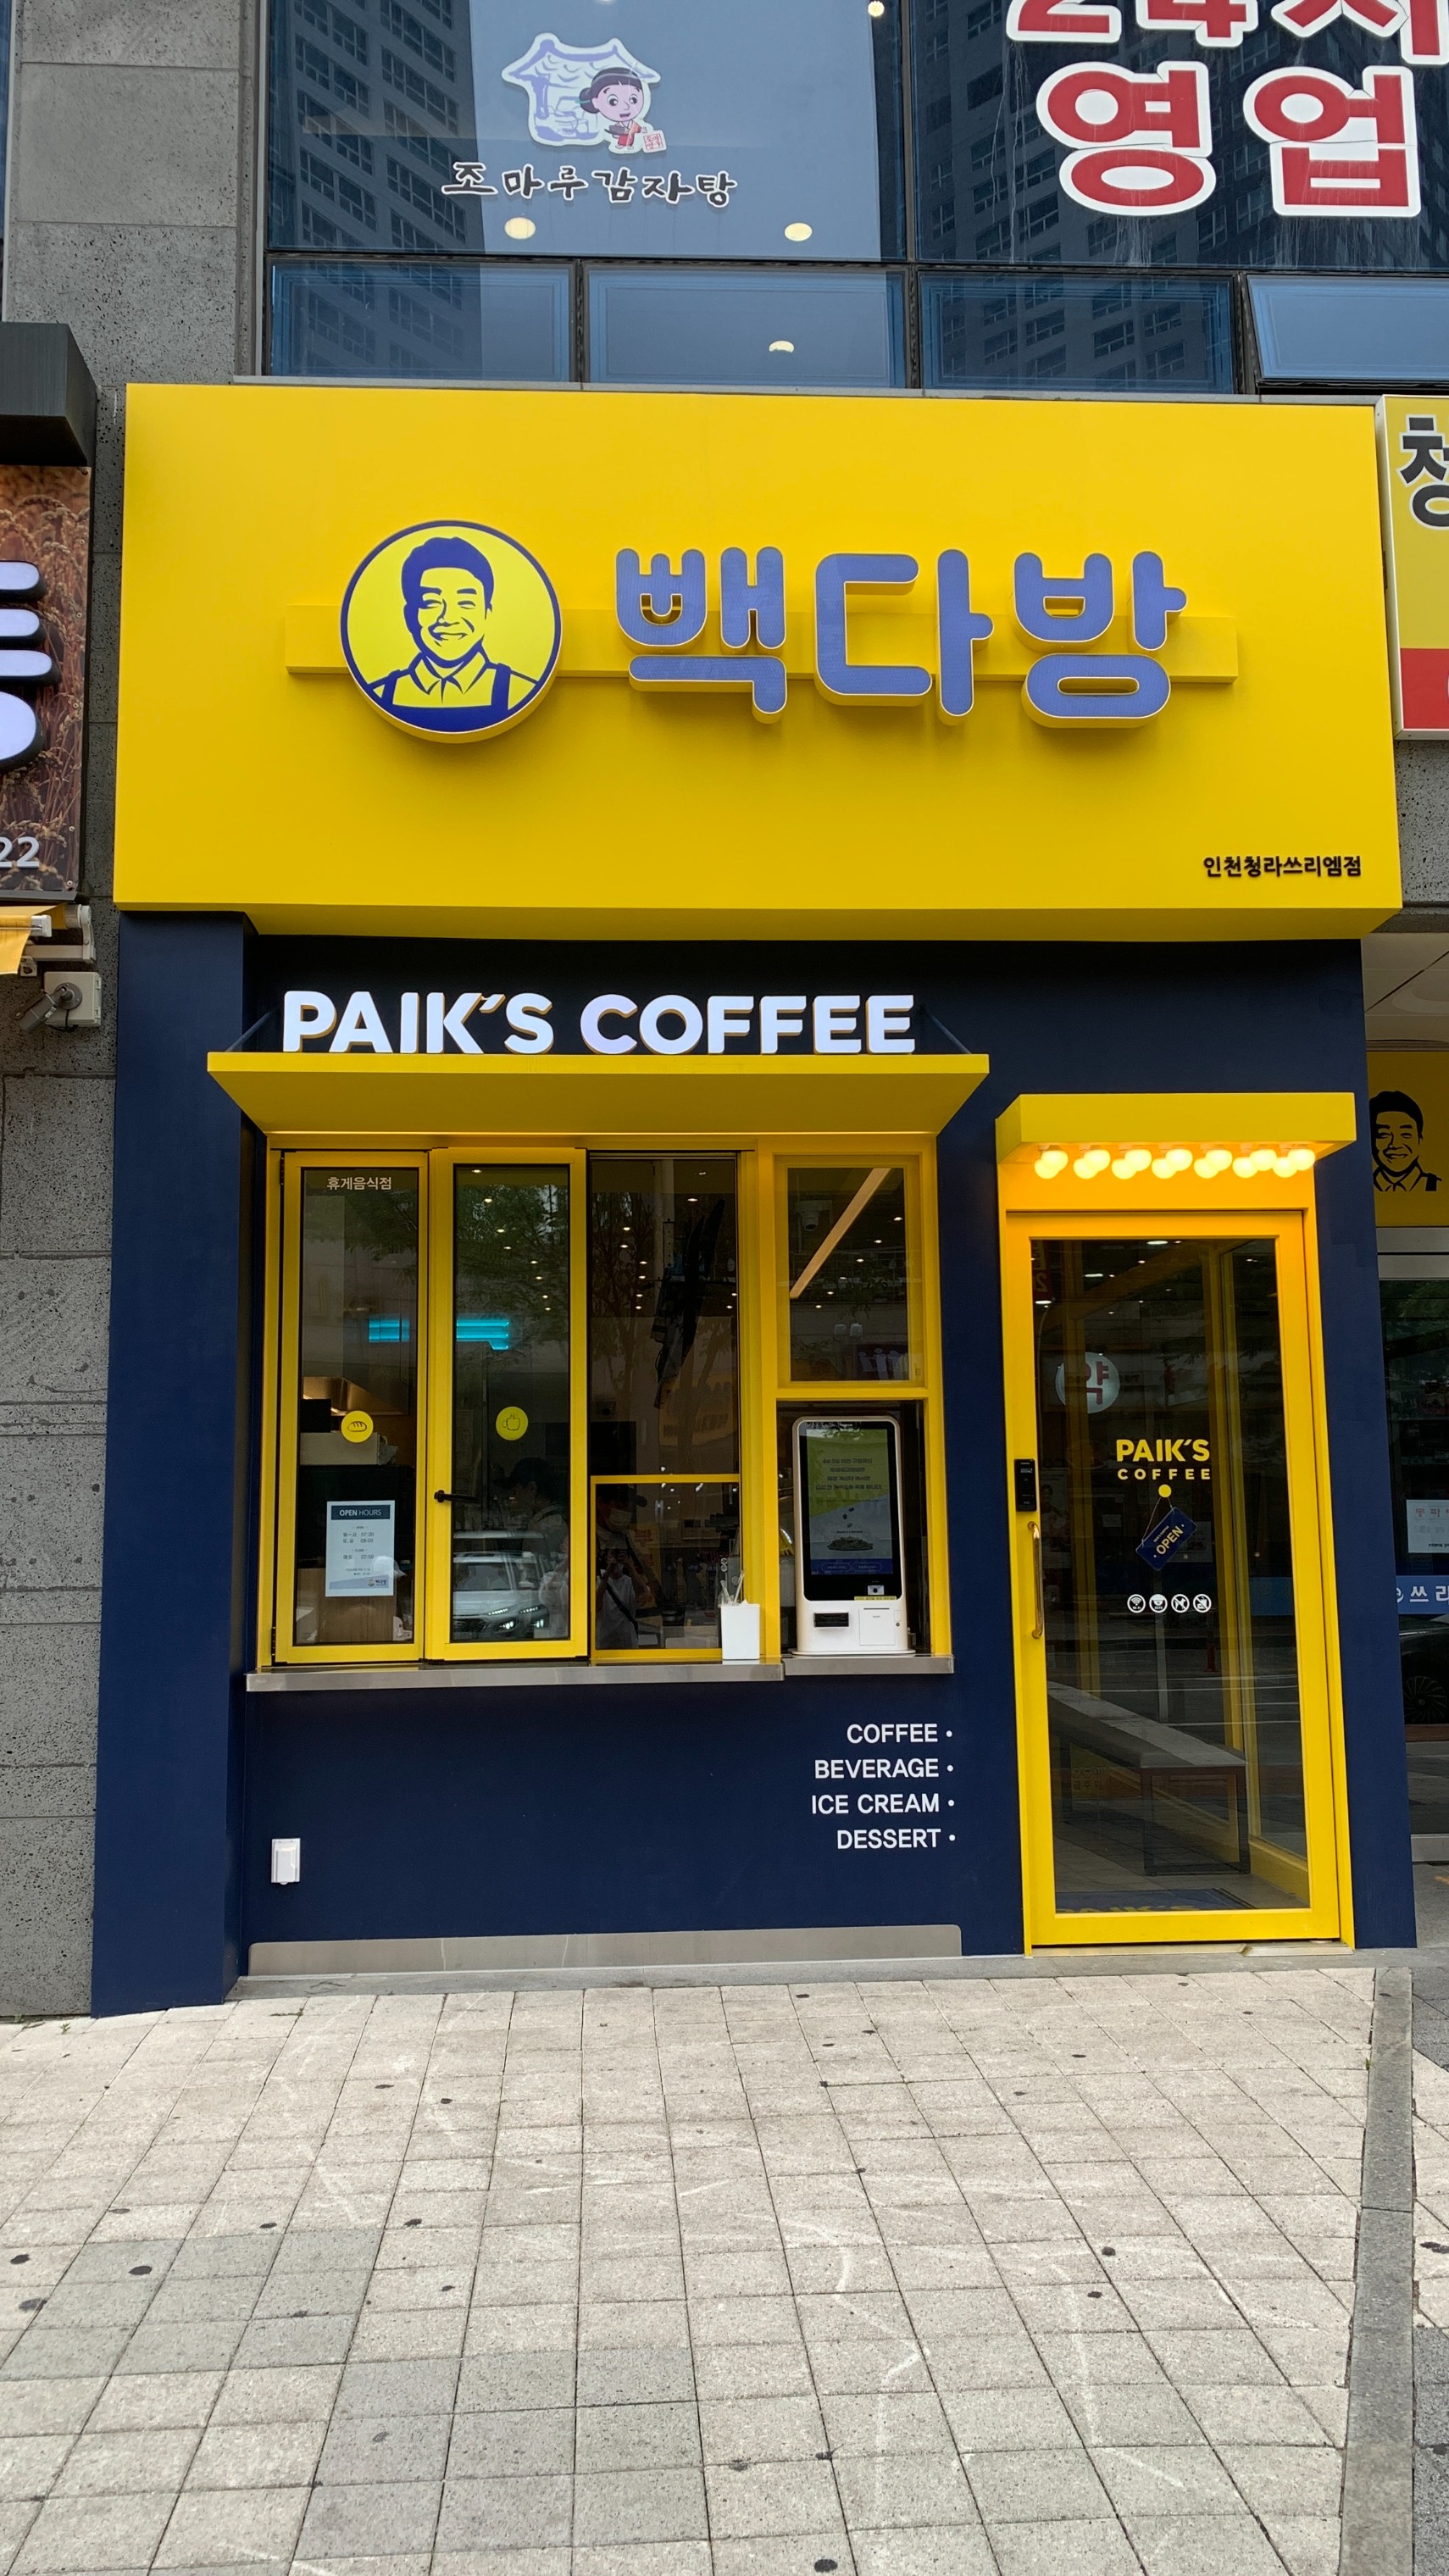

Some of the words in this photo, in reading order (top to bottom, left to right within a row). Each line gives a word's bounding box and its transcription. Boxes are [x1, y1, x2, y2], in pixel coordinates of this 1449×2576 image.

[1042, 66, 1415, 212] 영업
[616, 546, 1186, 723] 빽다방
[1203, 856, 1362, 877] 인천청라쓰리엠점
[283, 991, 553, 1054] PAIK'S
[580, 994, 915, 1055] COFFEE
[327, 1177, 391, 1190] 휴게음식점
[1116, 1439, 1210, 1462] PAIK'S
[1117, 1468, 1211, 1480] COFFEE
[1156, 1526, 1184, 1555] OPEN
[847, 1724, 938, 1744] COFFEE
[814, 1758, 939, 1779] BEVERAGE
[812, 1795, 849, 1814] ICE
[858, 1793, 940, 1814] CREAM
[837, 1829, 941, 1849] DESSERT
